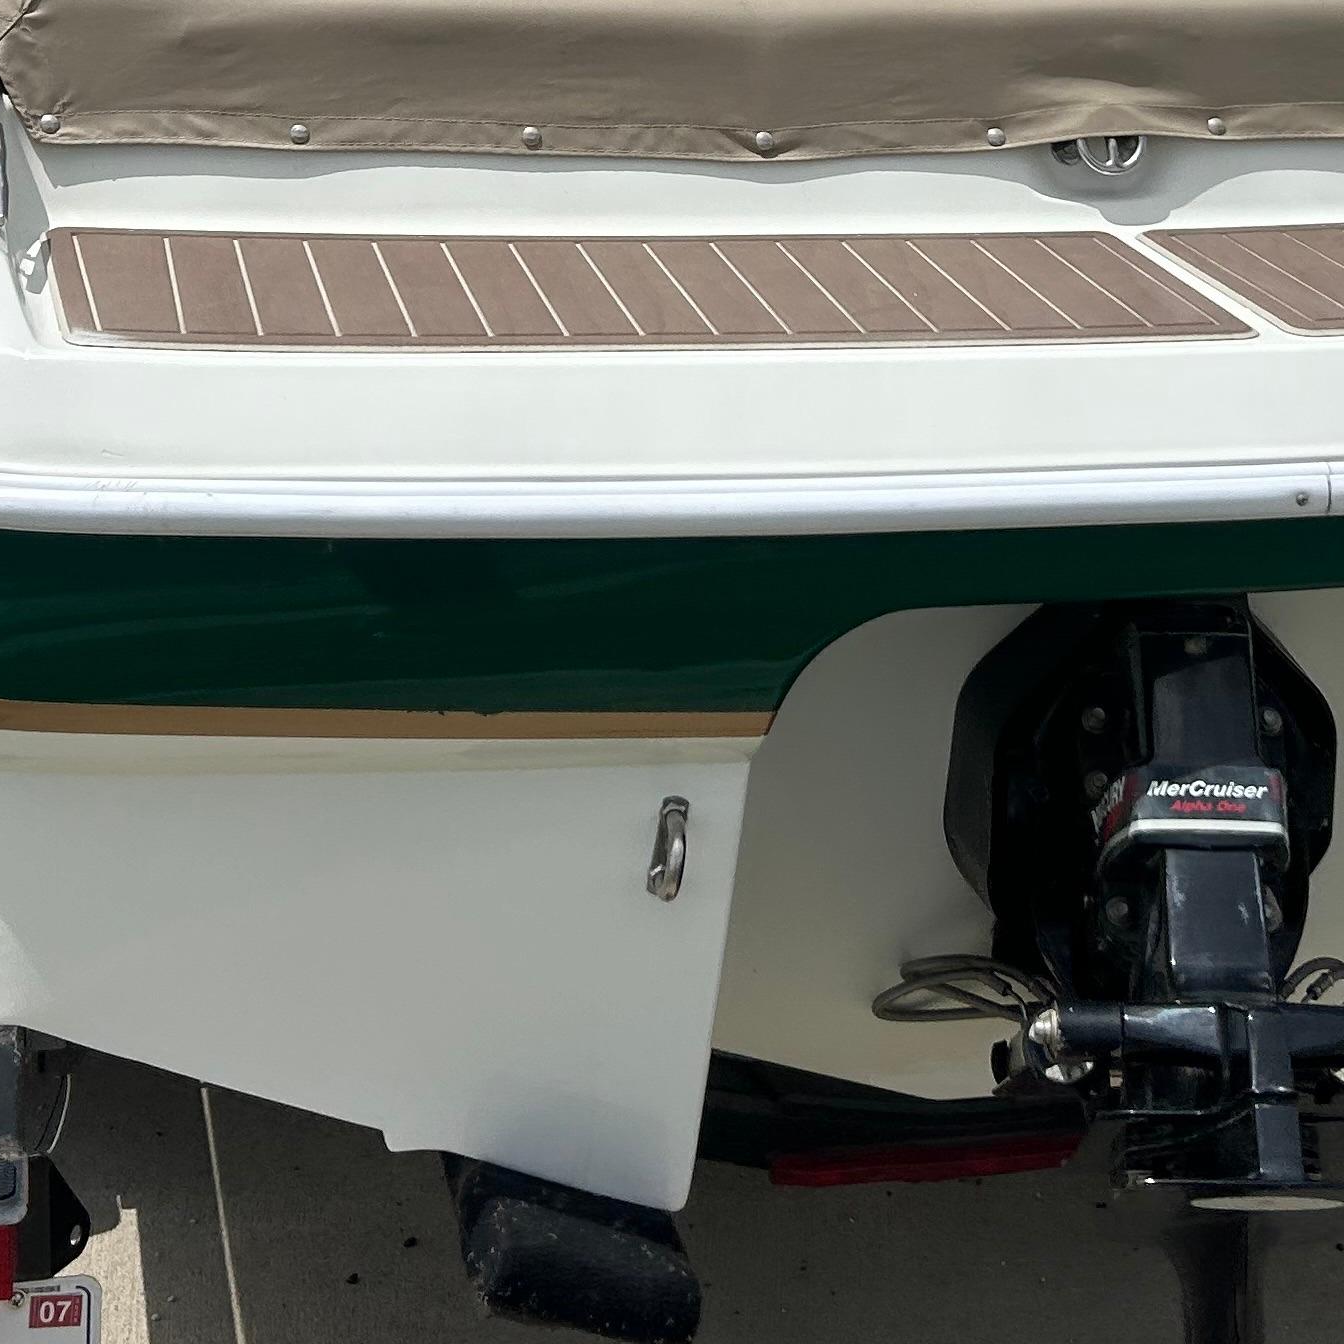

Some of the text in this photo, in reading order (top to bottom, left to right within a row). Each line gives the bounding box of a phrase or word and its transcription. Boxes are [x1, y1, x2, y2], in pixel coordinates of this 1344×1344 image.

[1147, 780, 1268, 799] MerCruiser
[1170, 799, 1247, 813] Alpha One
[40, 1300, 72, 1323] 07
